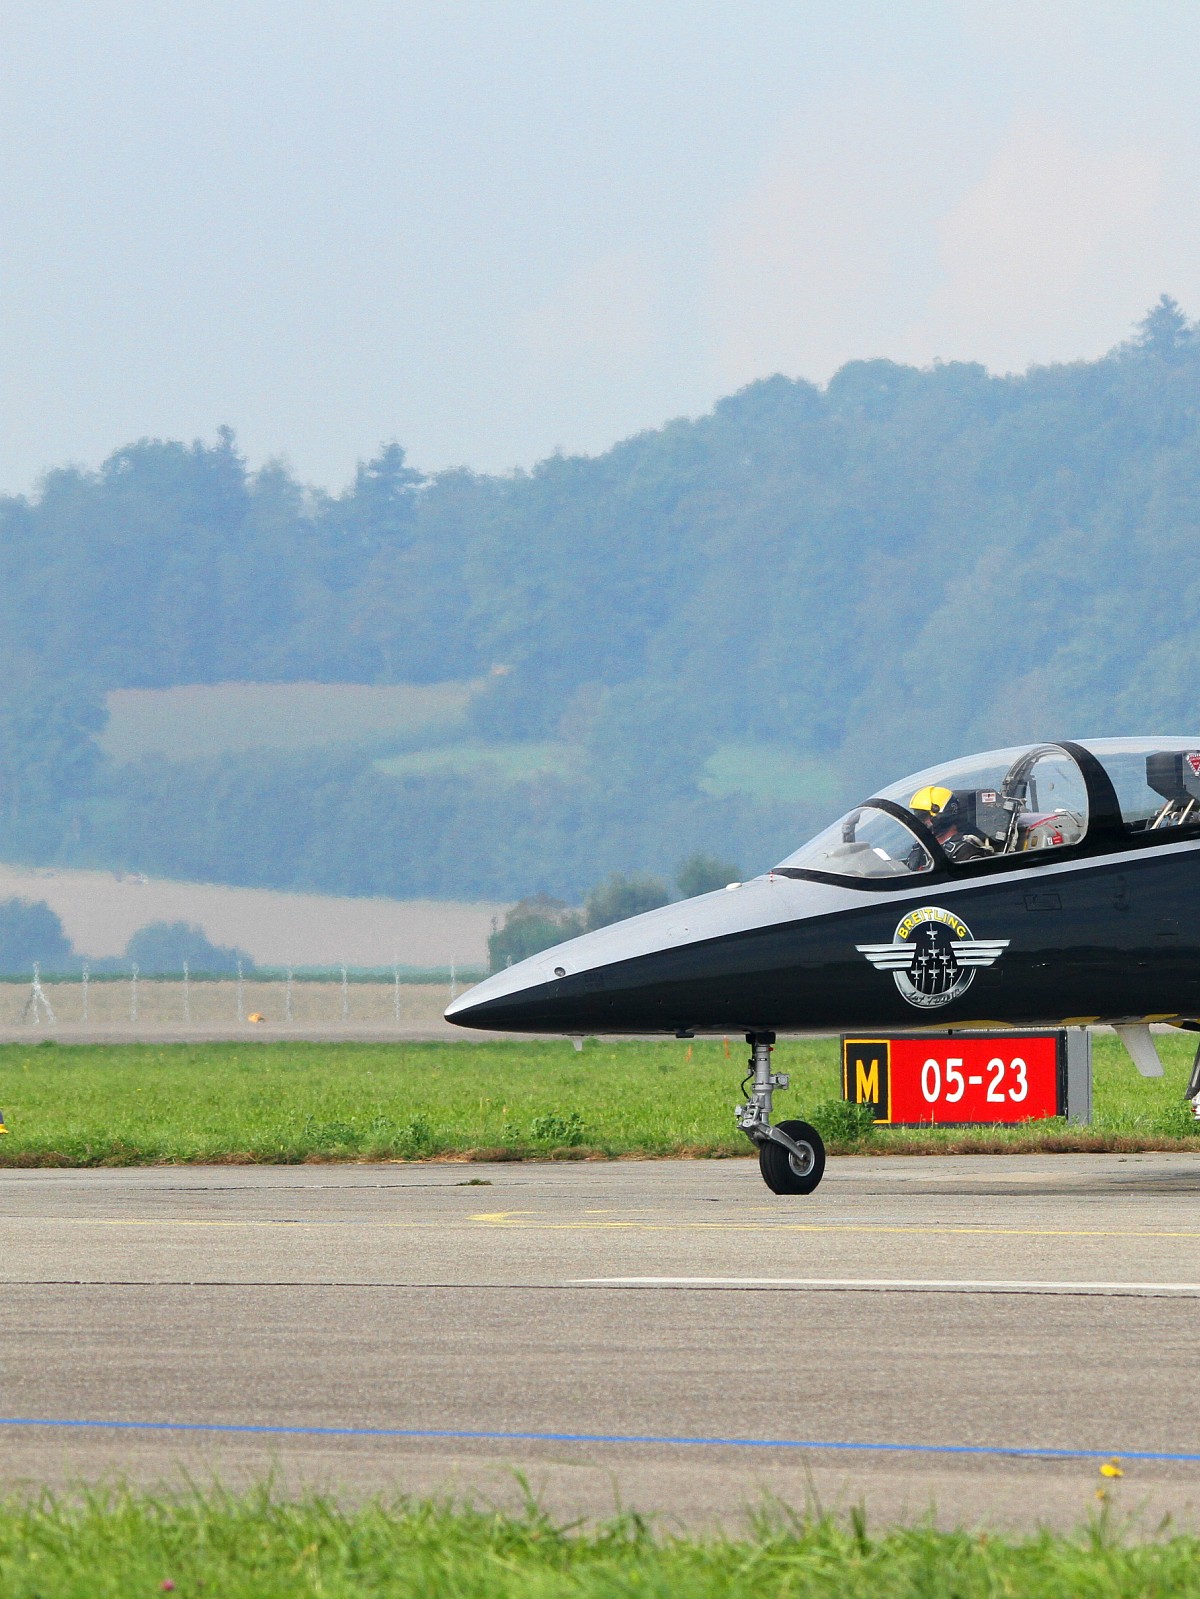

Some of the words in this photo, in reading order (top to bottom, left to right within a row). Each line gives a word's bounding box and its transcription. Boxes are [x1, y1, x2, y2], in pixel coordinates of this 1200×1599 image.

[898, 909, 967, 939] BREITLING
[856, 1059, 879, 1104] M
[921, 1057, 1028, 1103] 05-23
